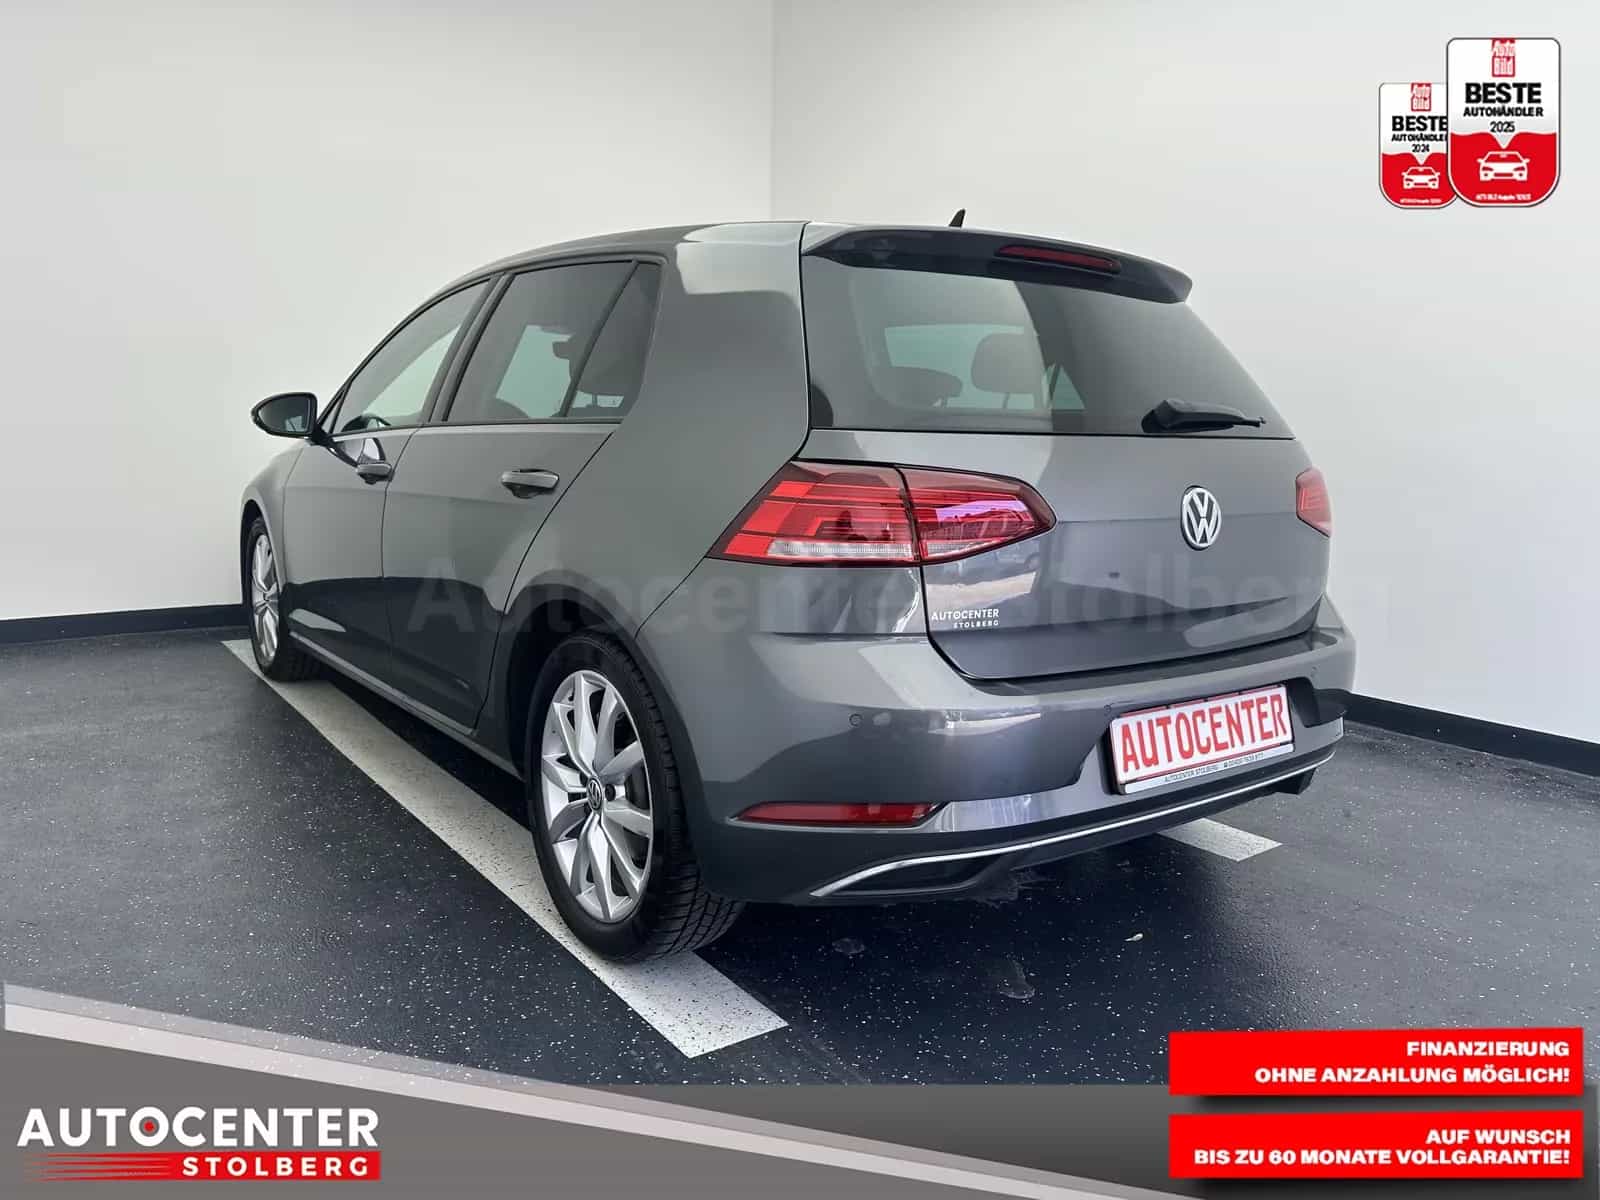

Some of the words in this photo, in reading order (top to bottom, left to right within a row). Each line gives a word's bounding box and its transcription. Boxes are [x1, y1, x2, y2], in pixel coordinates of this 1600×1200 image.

[931, 608, 999, 620] AUTOCENTER
[953, 620, 999, 629] STOLBERG
[1120, 693, 1288, 773] AUTOCENTER
